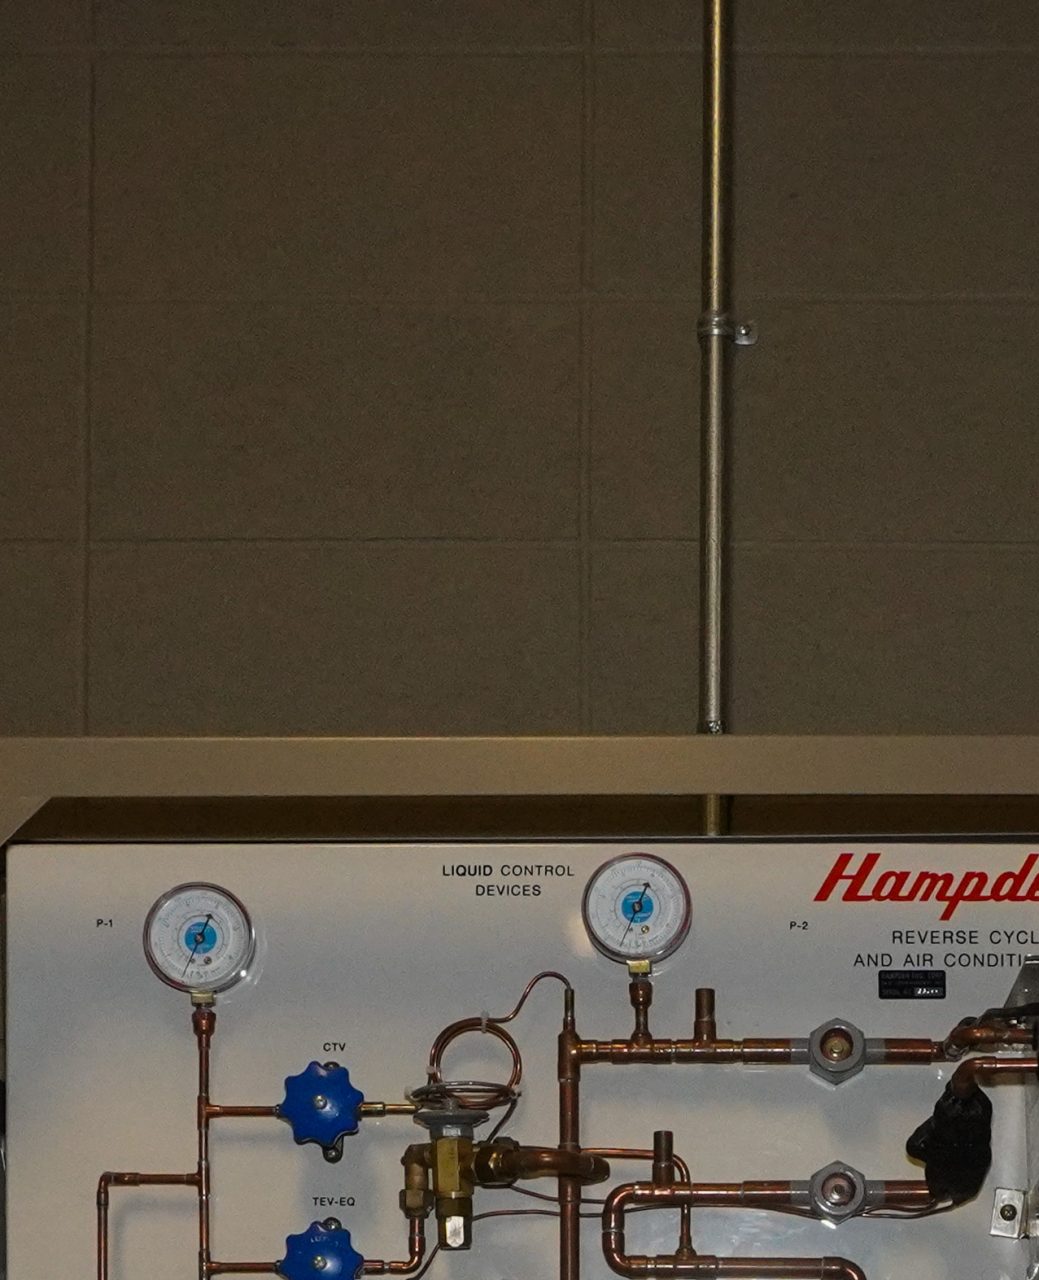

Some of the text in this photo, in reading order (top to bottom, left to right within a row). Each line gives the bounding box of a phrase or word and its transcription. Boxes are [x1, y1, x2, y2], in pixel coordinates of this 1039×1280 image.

[442, 864, 574, 877] LIQUID CONTROL
[475, 884, 542, 897] DEVICES
[96, 918, 114, 928] P-1
[789, 920, 809, 931] P-2
[892, 930, 979, 945] REVERSE
[853, 953, 1022, 968] AND AIR CONDITI
[322, 1042, 346, 1052] CTV
[312, 1196, 356, 1207] TEV-EQ
